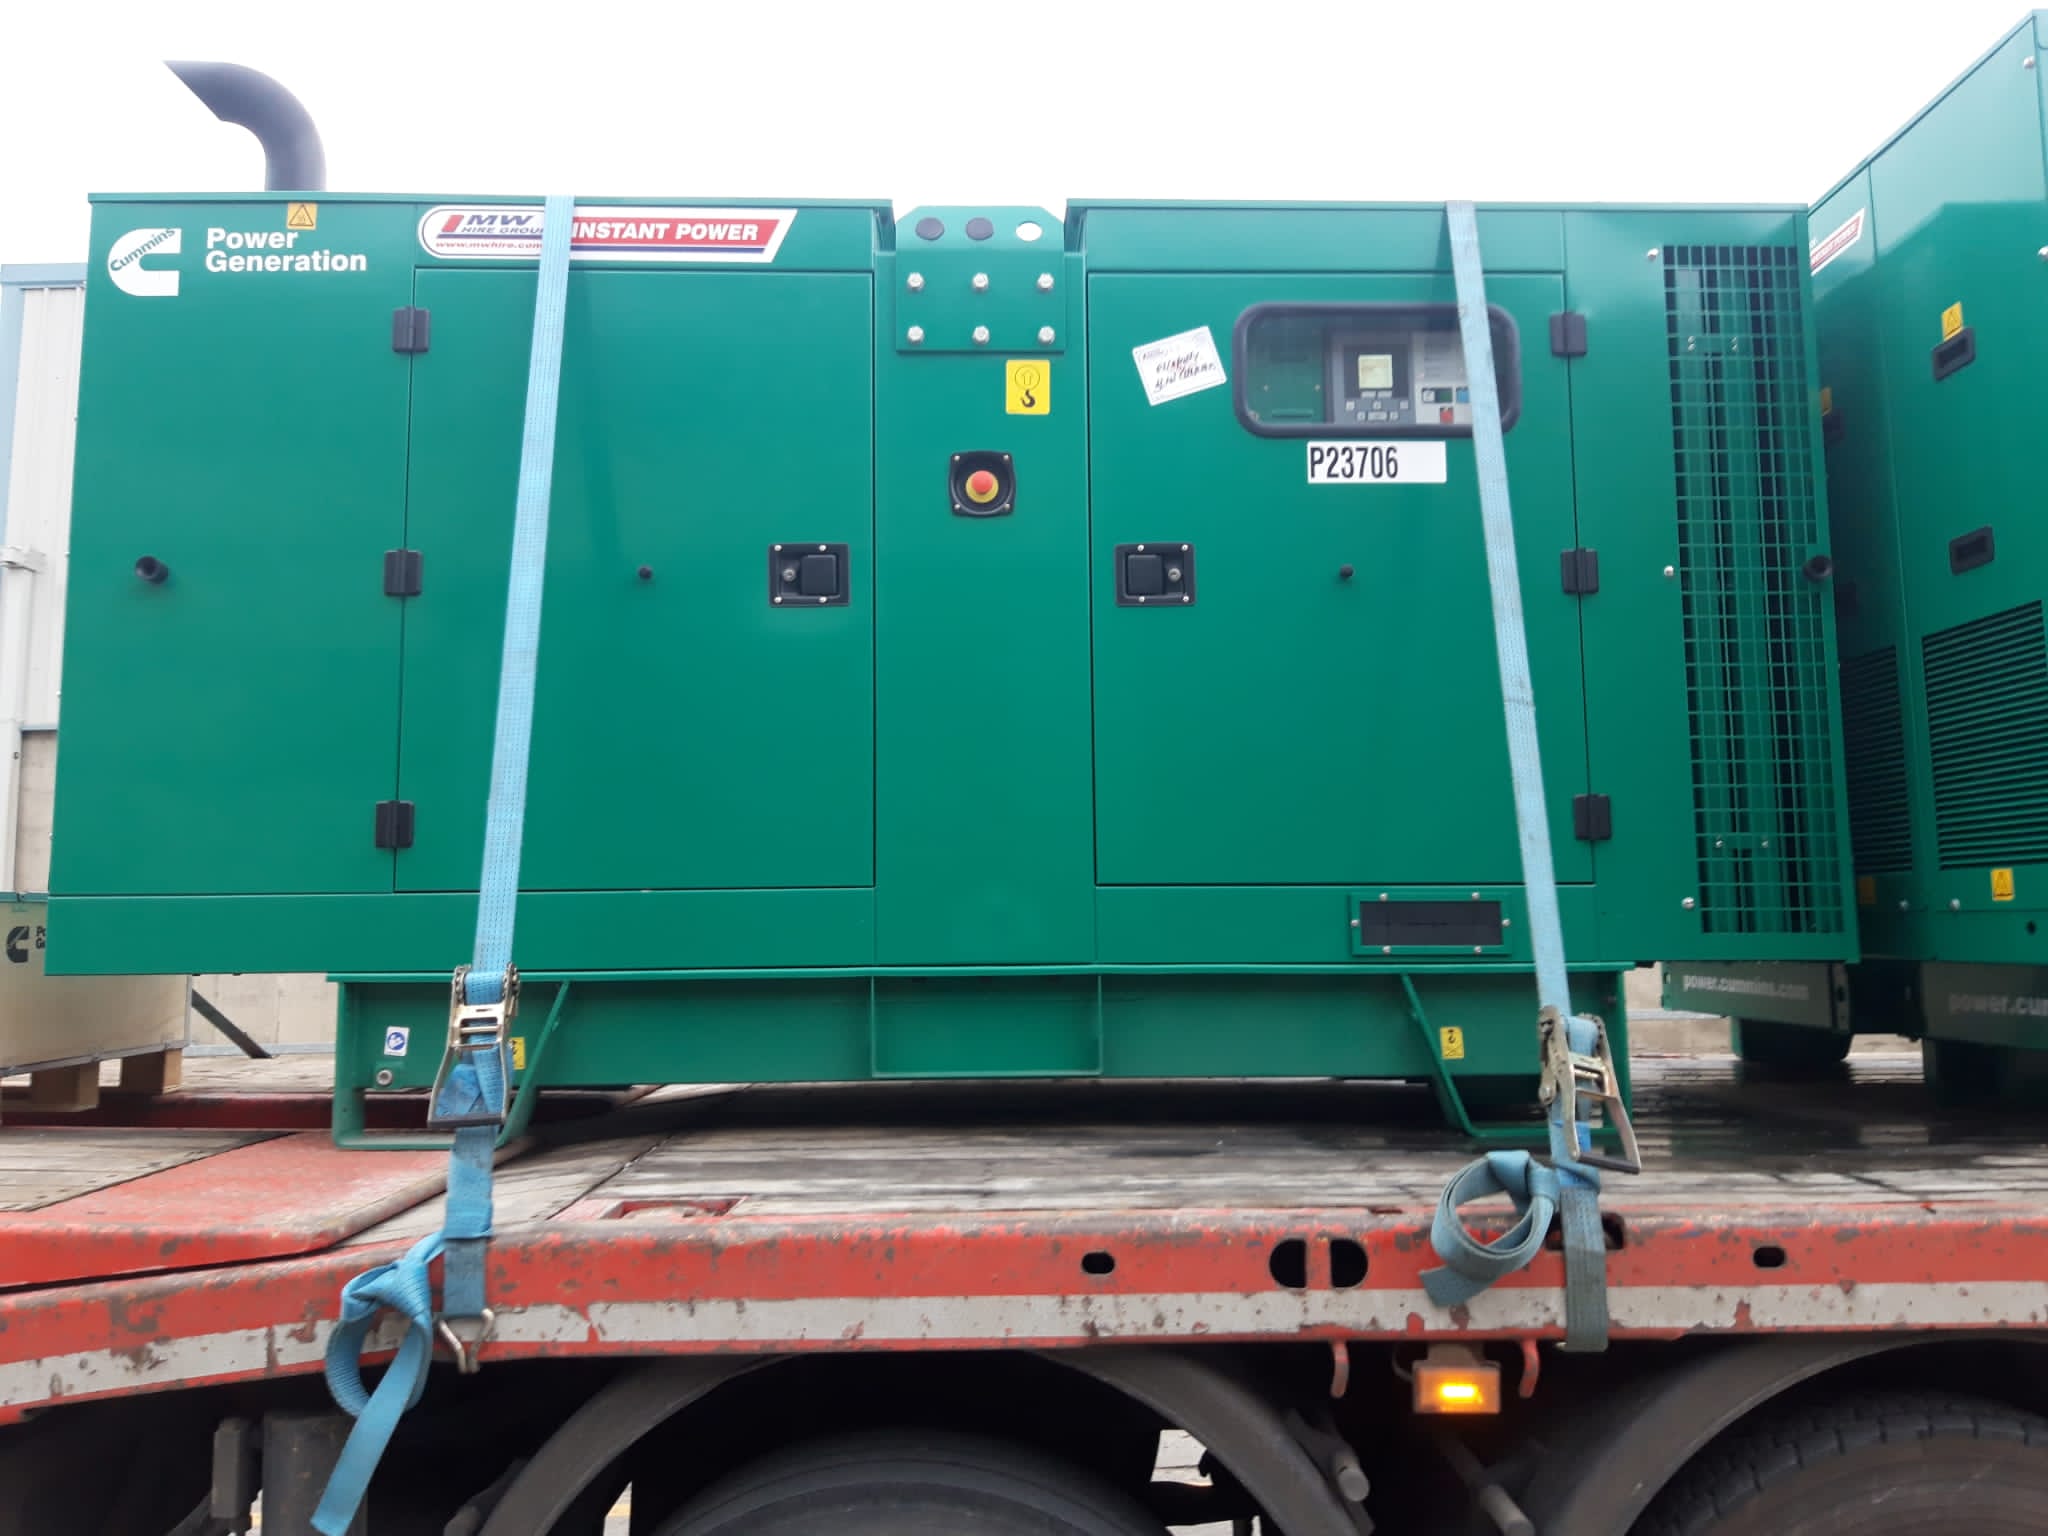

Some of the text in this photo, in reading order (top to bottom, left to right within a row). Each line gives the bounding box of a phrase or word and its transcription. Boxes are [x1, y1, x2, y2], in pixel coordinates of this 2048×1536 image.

[206, 228, 299, 249] Power
[461, 226, 495, 234] HIRE
[571, 221, 760, 241] INSTANT POWER
[109, 229, 176, 272] Cummins
[204, 250, 367, 272] Generation
[1309, 446, 1399, 479] P23706
[1682, 974, 1809, 1000] power.cummins.com
